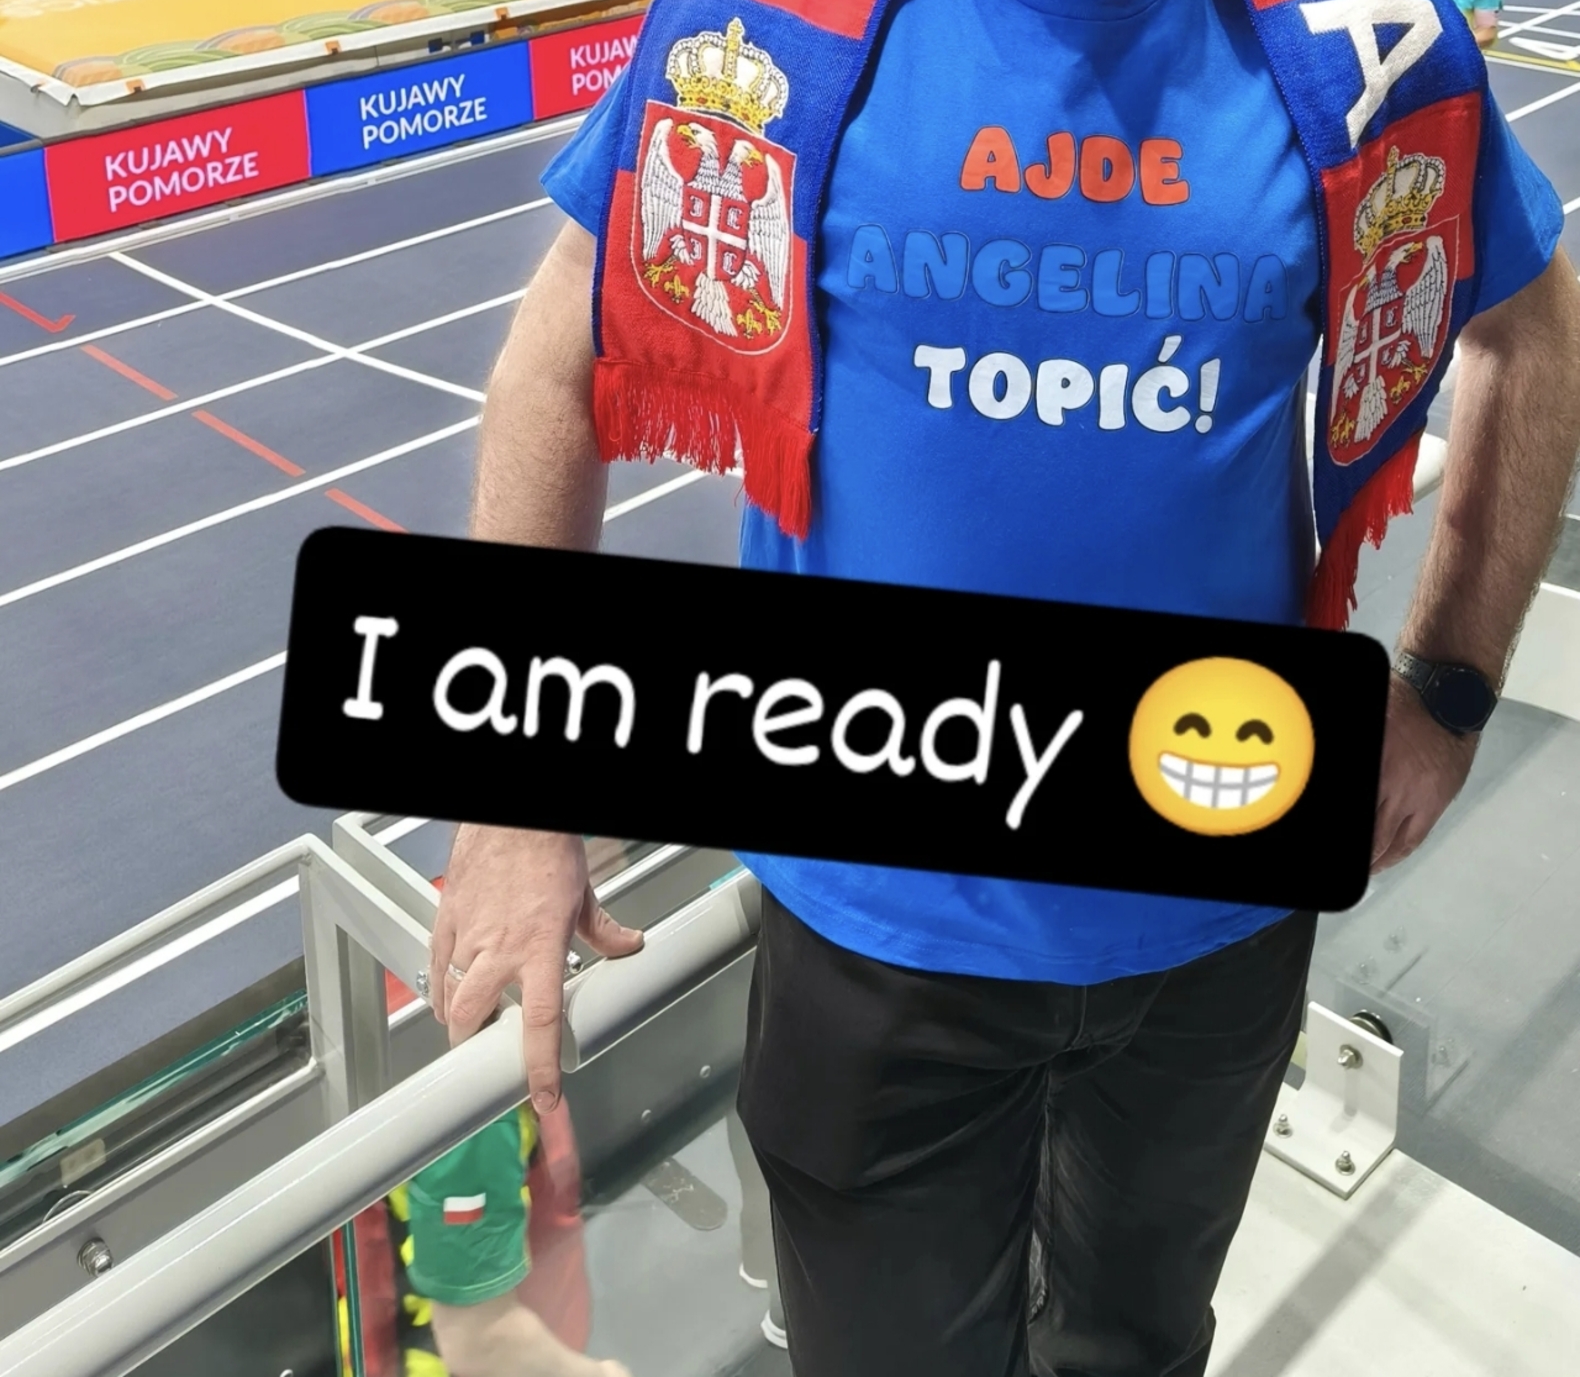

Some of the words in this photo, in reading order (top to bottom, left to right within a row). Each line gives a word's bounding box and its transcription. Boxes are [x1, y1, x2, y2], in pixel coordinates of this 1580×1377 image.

[570, 35, 637, 70] KUJAW
[359, 74, 466, 120] KUJAWY
[362, 98, 488, 150] POMORZE
[104, 127, 234, 181] KUJAWY
[108, 151, 260, 213] POMORZE
[959, 126, 1190, 206] AJDE
[846, 225, 1289, 322] ANGELINA
[912, 335, 1223, 434] TOPIĆ!
